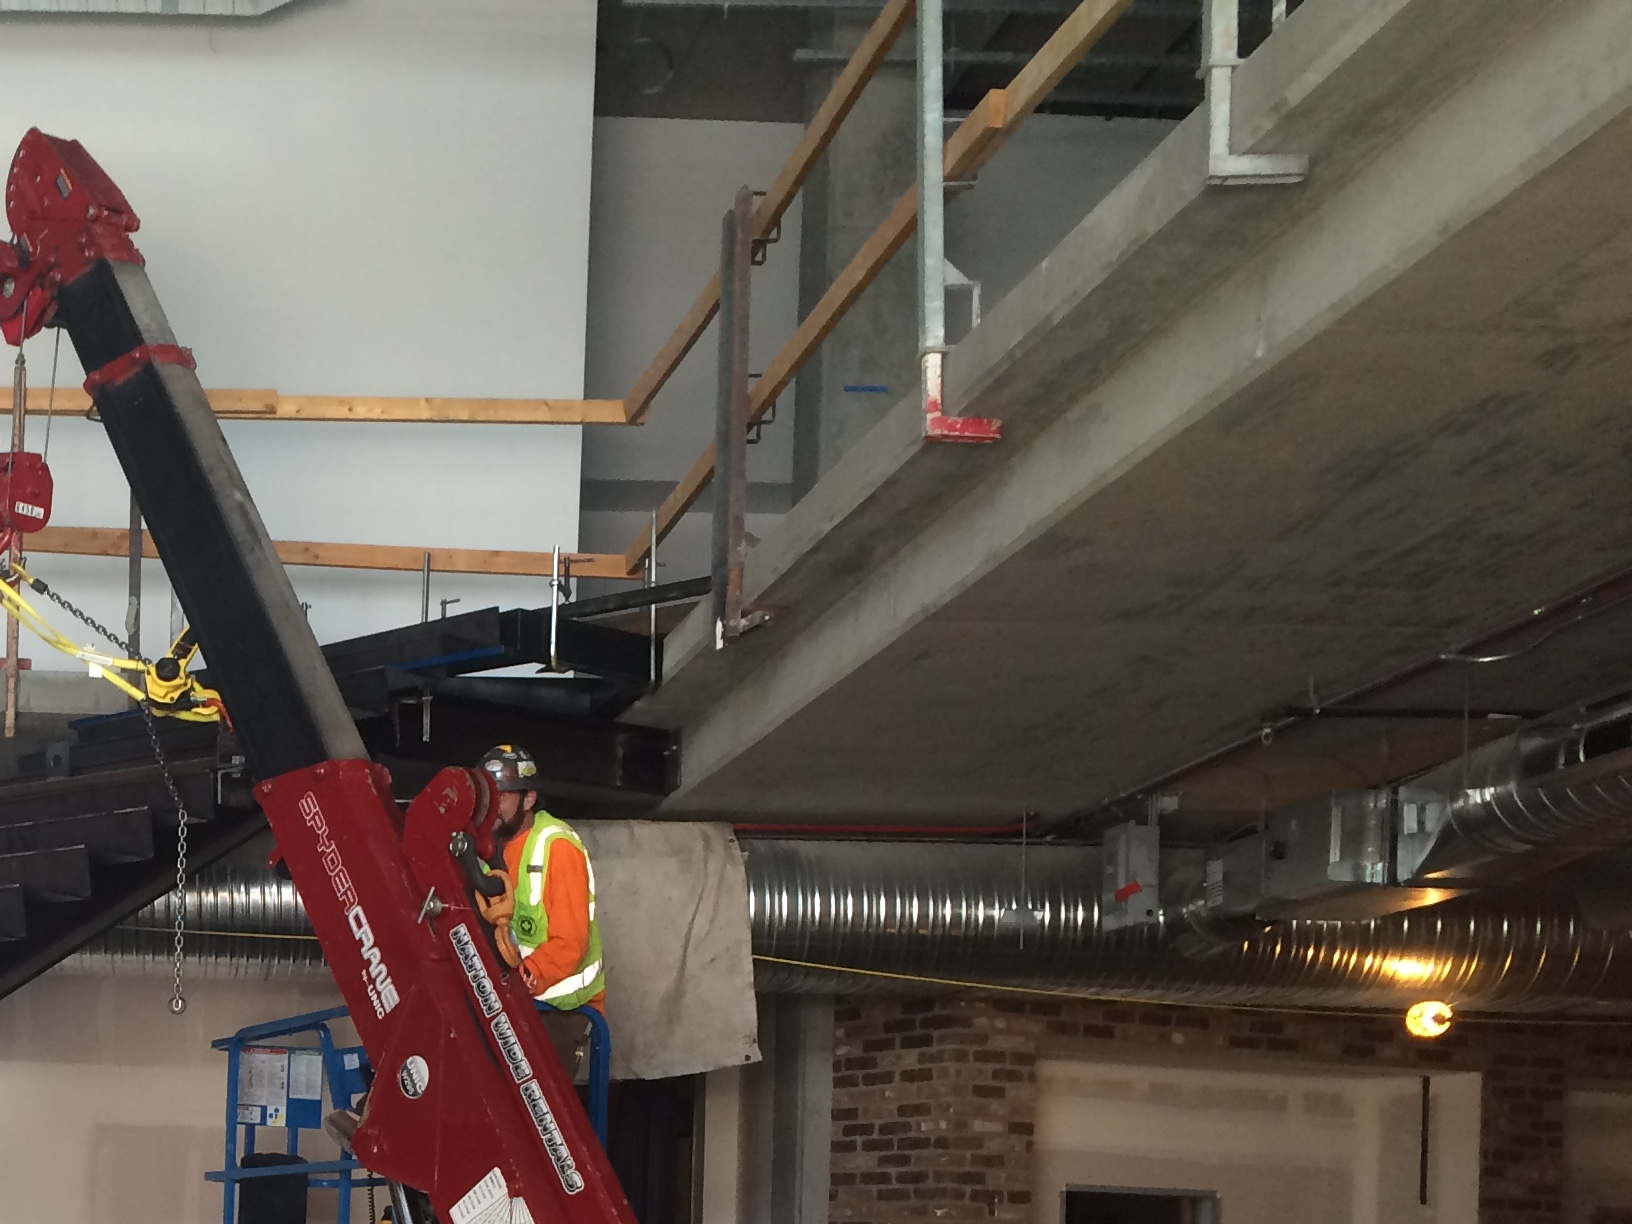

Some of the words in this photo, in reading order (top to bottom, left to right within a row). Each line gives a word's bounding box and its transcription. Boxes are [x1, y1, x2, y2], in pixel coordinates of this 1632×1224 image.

[299, 791, 401, 1014] SPYDERCRANE
[367, 983, 385, 1020] UNIC
[449, 922, 503, 1018] NATION
[490, 1011, 533, 1084] WIDE
[519, 1078, 585, 1195] RENTALS
[406, 1057, 426, 1094] UNIC
